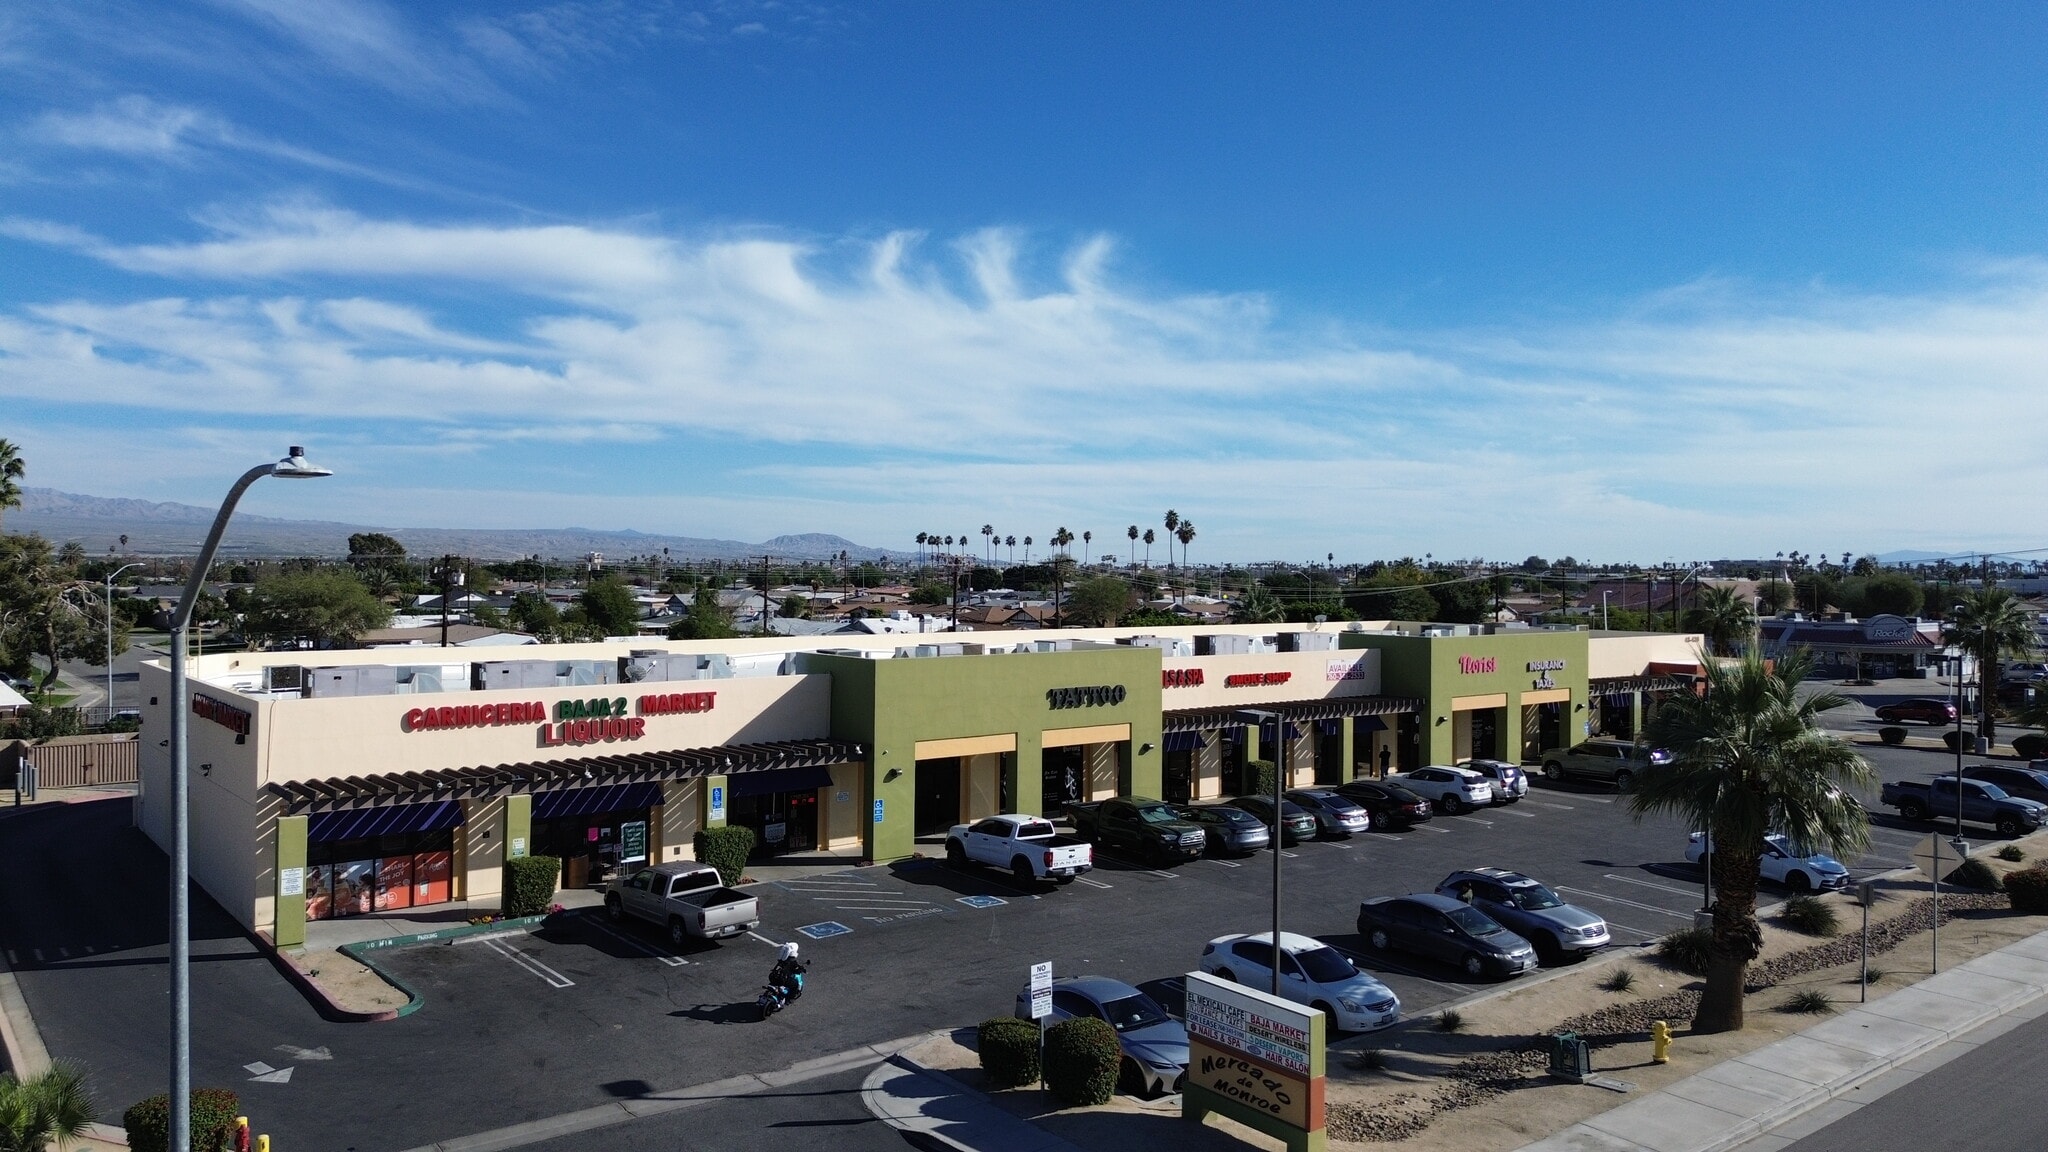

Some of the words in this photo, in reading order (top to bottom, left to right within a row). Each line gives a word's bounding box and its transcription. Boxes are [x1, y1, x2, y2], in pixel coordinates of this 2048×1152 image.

[1874, 629, 1908, 638] Rocket
[1177, 669, 1184, 685] &
[1186, 669, 1204, 685] SPA
[1229, 674, 1264, 686] SMOKE
[1264, 672, 1291, 683] SHOP
[1329, 664, 1363, 672] AVAILABLE
[1049, 685, 1126, 708] TATTOO
[406, 701, 546, 731] CARNICERIA
[559, 698, 611, 719] BAJA
[614, 697, 627, 716] 2
[640, 691, 717, 714] MARKET
[544, 717, 646, 745] LIQUOR
[392, 870, 405, 879] JOY
[379, 939, 393, 947] MIN
[417, 933, 438, 941] PARKING
[1036, 964, 1046, 973] NO
[1188, 993, 1195, 1002] EL
[1197, 995, 1227, 1013] MEXICALI
[1228, 1006, 1245, 1020] CAFE
[1187, 1012, 1198, 1022] FOR
[1199, 1017, 1218, 1029] LEASE
[1226, 1015, 1244, 1029] TAXES
[1250, 1014, 1270, 1029] BAJA
[1272, 1021, 1306, 1042] MARKET
[1198, 1025, 1219, 1040] NAILS
[1220, 1034, 1225, 1042] &
[1228, 1037, 1241, 1048] SPA
[1249, 1025, 1273, 1040] DESERT
[1275, 1033, 1306, 1052] WIRELESS
[1255, 1037, 1277, 1052] DESERT
[1278, 1046, 1304, 1061] VAPORS
[1265, 1051, 1283, 1064] HAIR
[1284, 1059, 1309, 1075] SALON
[1201, 1055, 1291, 1105] Mercado
[1236, 1076, 1253, 1089] de
[1213, 1079, 1281, 1114] Monroe
